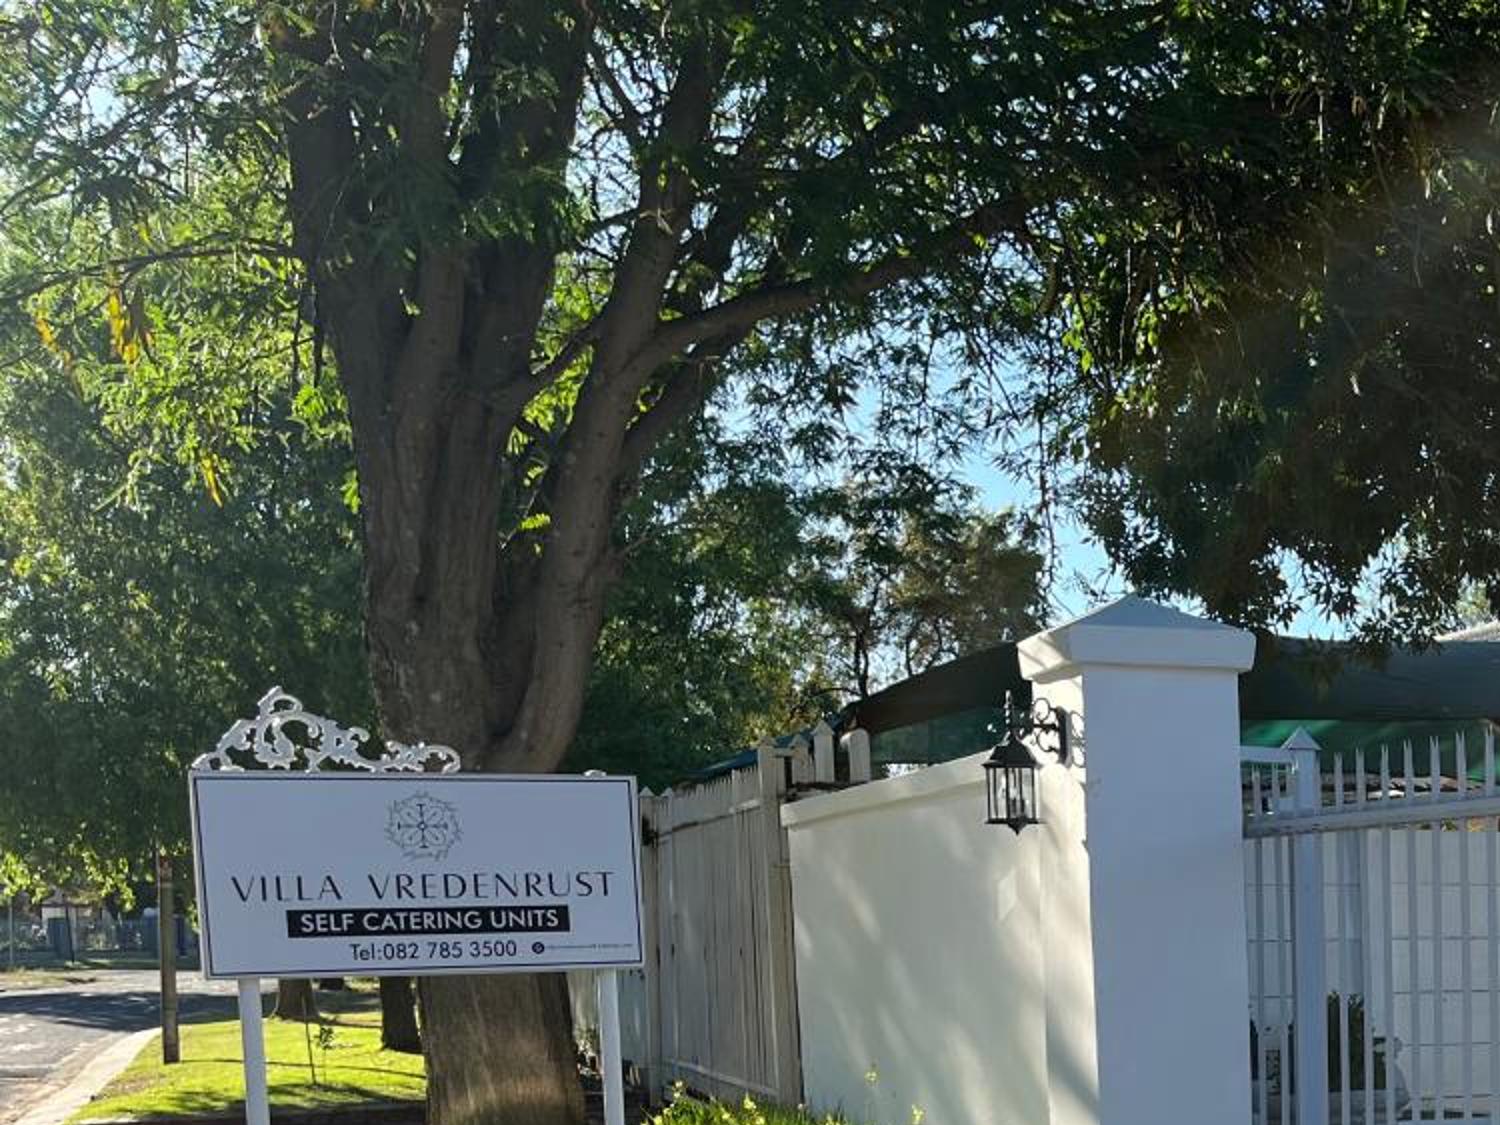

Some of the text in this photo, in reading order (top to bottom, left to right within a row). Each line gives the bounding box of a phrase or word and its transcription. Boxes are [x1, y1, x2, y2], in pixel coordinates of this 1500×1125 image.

[231, 871, 615, 903] VILLA VREDENRUST
[301, 908, 559, 933] SELF CATERING UNITS
[351, 940, 517, 961] Tel:082 785 3500
